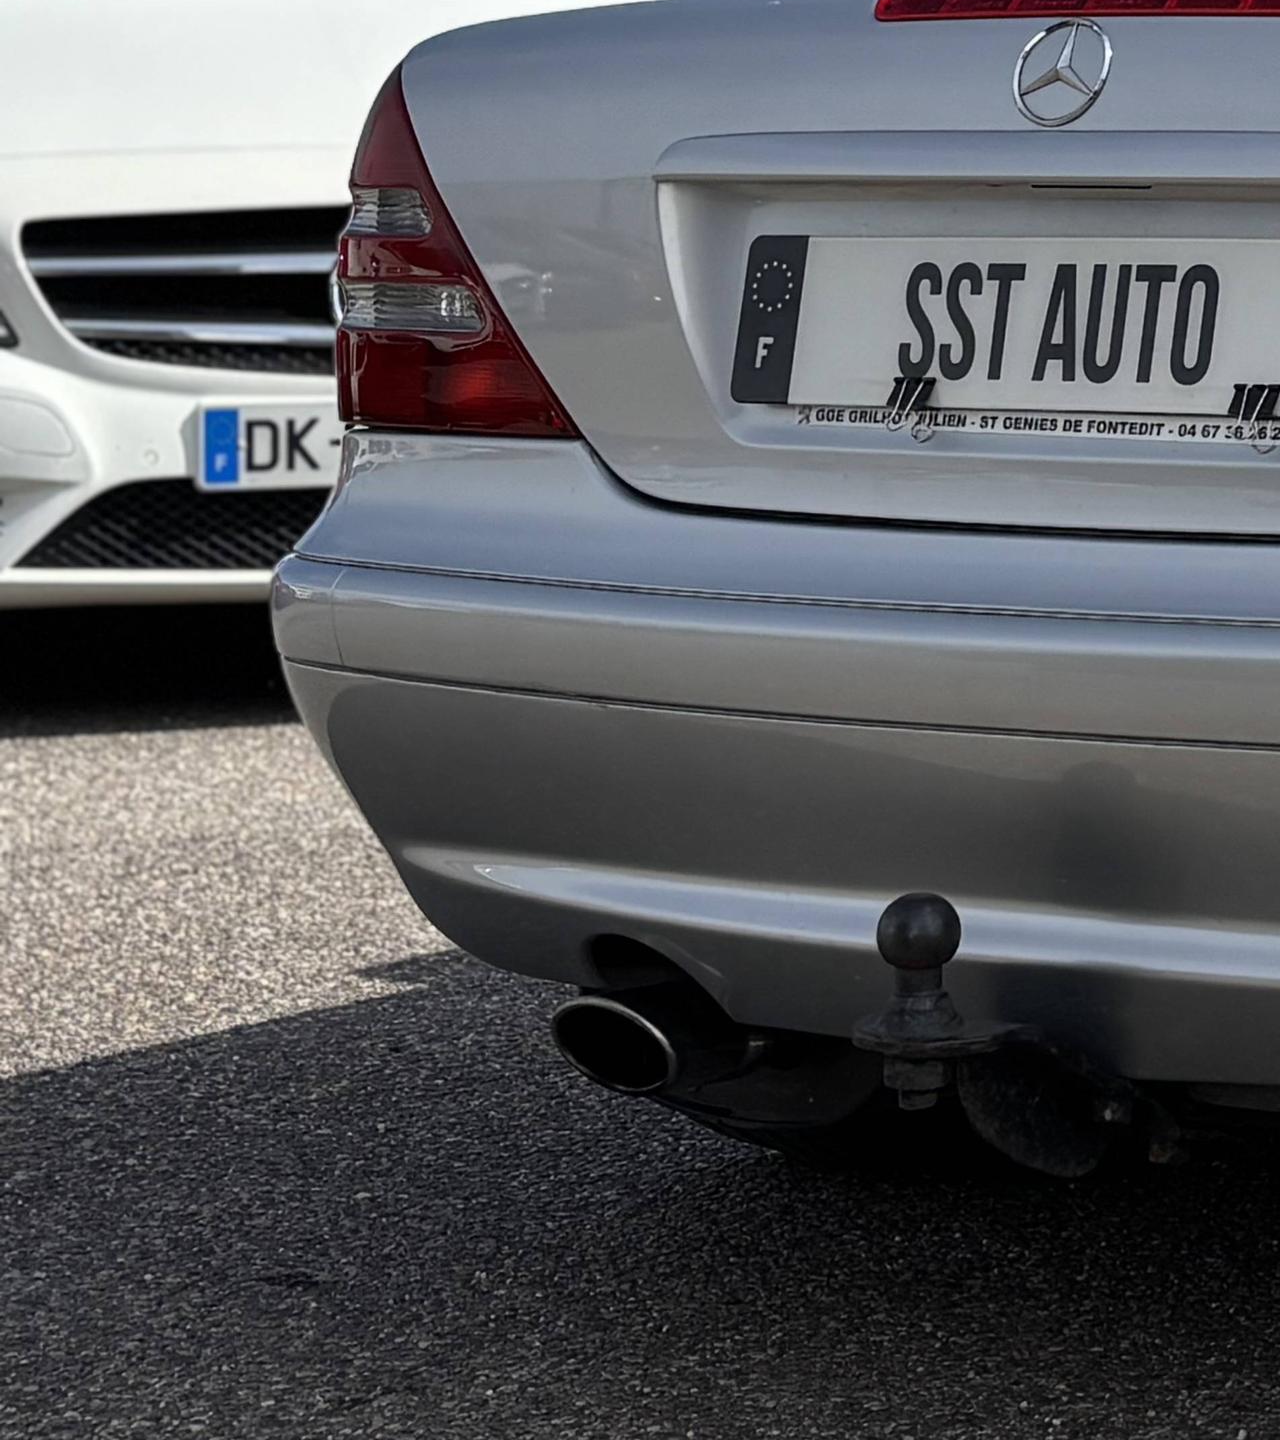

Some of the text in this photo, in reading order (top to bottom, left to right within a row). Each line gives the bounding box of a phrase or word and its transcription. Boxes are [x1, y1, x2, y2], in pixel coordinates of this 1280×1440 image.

[898, 261, 1219, 385] SST AUTO
[755, 336, 774, 369] F
[979, 416, 998, 430] ST
[1002, 417, 1058, 431] GENIES
[1062, 419, 1082, 433] DE
[1087, 420, 1165, 436] FONTEDIT
[1178, 424, 1196, 437] 04
[1201, 425, 1220, 439] 67
